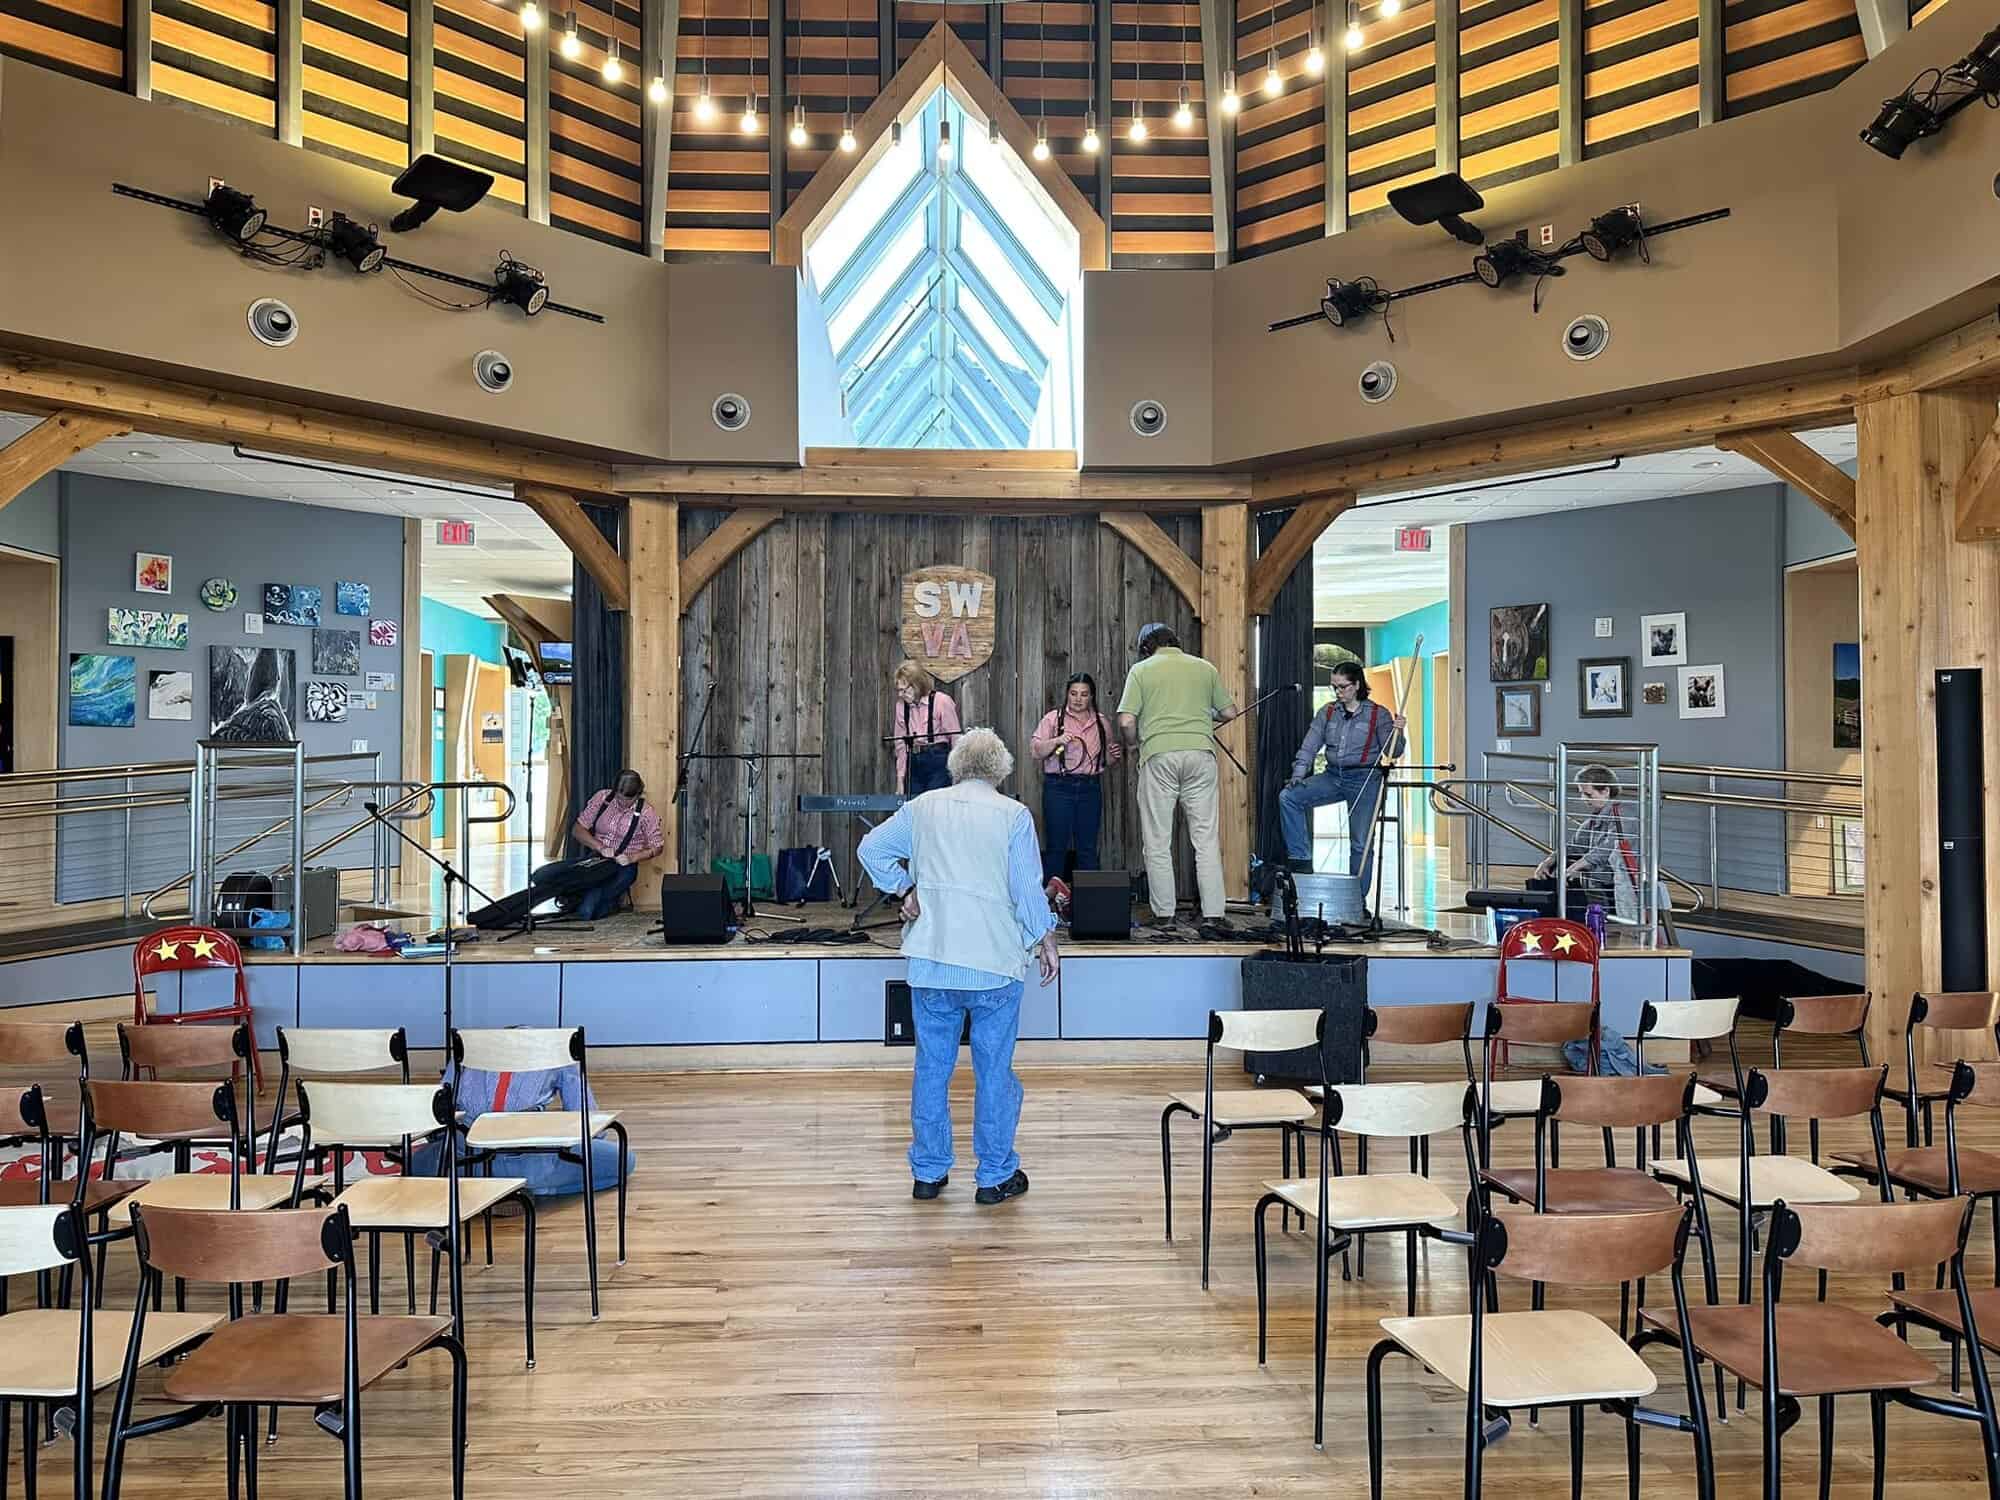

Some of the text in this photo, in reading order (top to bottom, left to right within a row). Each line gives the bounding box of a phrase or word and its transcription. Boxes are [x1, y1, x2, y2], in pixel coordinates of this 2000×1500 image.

[442, 522, 470, 544] EXIT
[1401, 529, 1425, 550] EXIT
[914, 581, 983, 618] SW
[920, 623, 972, 658] VA
